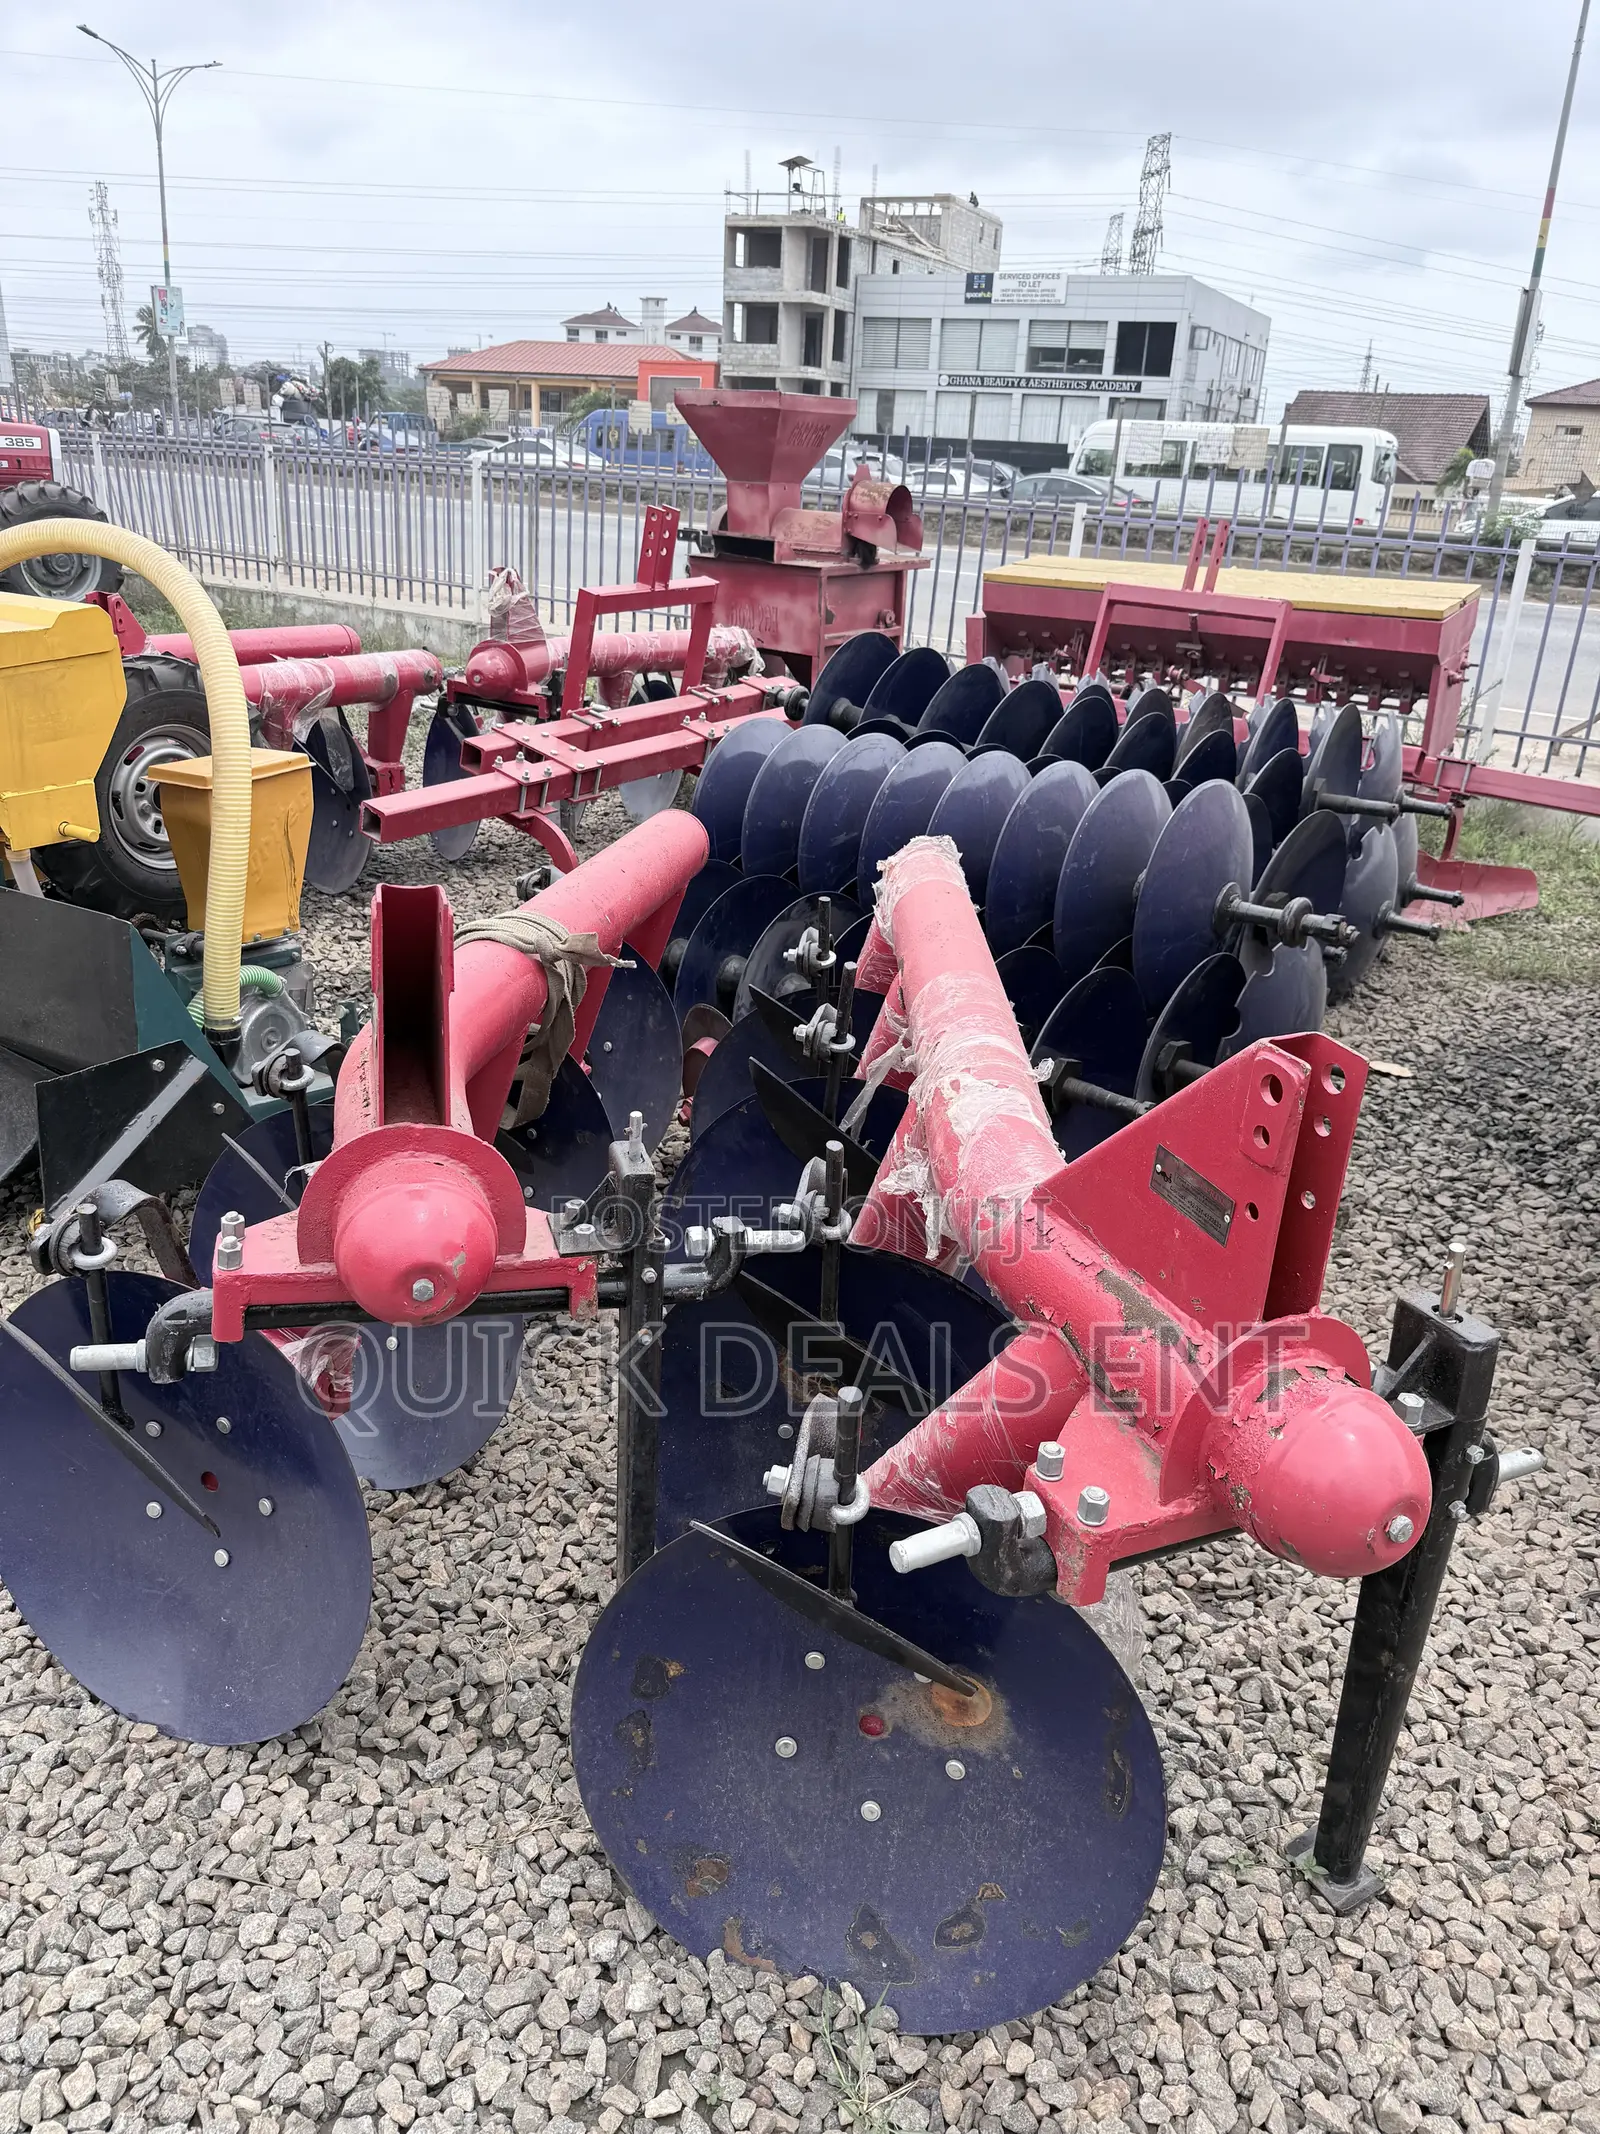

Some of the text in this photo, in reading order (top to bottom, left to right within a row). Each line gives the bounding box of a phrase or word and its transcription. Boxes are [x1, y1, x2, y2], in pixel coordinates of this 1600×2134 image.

[999, 272, 1061, 280] SERVICED OFFICES
[1017, 280, 1042, 288] TO LET
[949, 376, 1138, 392] GHANA BEAUTY & AESTHETICS ACADEMY
[4, 437, 35, 448] 385
